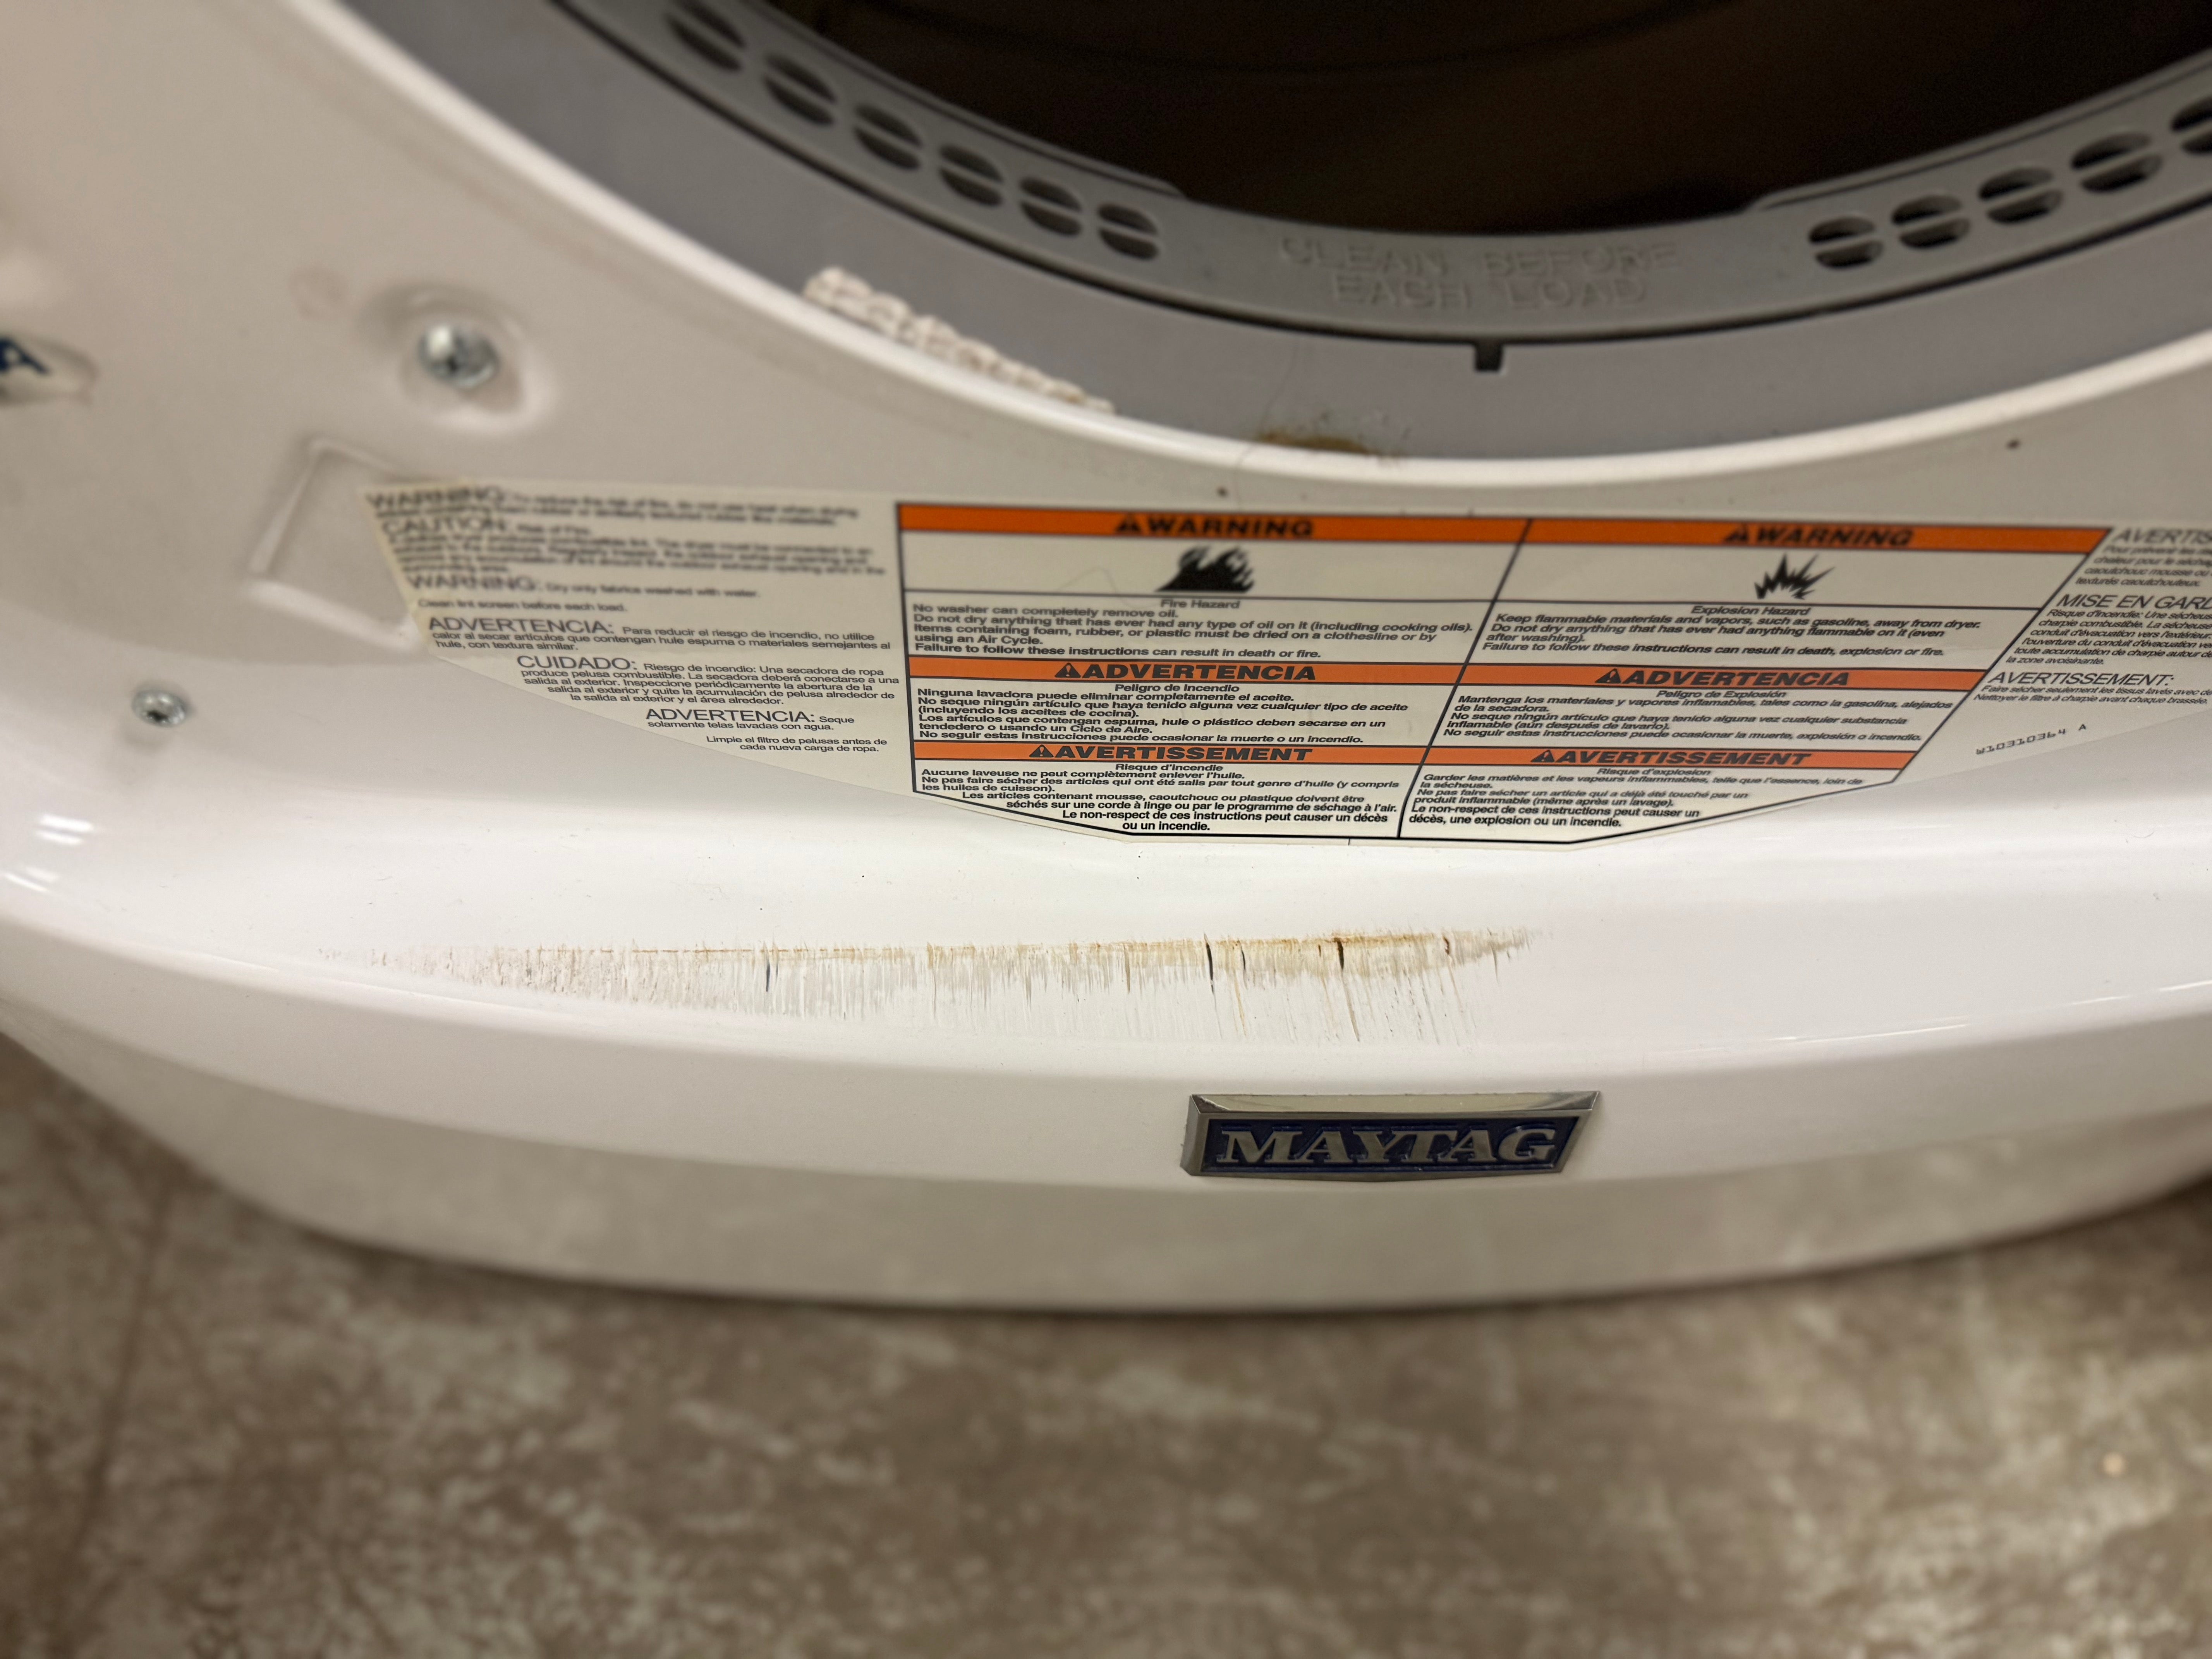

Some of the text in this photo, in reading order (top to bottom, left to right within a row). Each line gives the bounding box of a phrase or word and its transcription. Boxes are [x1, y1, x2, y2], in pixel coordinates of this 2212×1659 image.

[1279, 237, 1676, 276] CLEAN BEFORE
[1332, 274, 1647, 308] EACH LOAD
[1149, 518, 1314, 536] WARNING
[1758, 528, 1913, 546] WARNING
[1160, 600, 1240, 609] Fire Hazard
[2056, 594, 2118, 607] MISE
[2116, 595, 2154, 608] EN
[1691, 606, 1811, 616] Explosion Hazard
[429, 617, 615, 634] ADVERTENCIA:
[622, 627, 651, 635] Para
[654, 627, 694, 636] reducir
[712, 629, 748, 639] riesgo
[751, 630, 766, 638] de
[769, 630, 820, 640] incendio,
[842, 632, 874, 641] utilice
[915, 643, 962, 653] Failure
[965, 644, 979, 653] to
[982, 644, 1024, 654] follow
[1027, 645, 1065, 654] these
[1069, 646, 1149, 656] instructions
[1181, 647, 1219, 656] result
[1222, 648, 1234, 657] in
[1238, 648, 1275, 657] death
[1297, 649, 1321, 658] fire.
[1482, 642, 1528, 651] Failure
[1549, 643, 1590, 652] follow
[1592, 644, 1629, 652] these
[1632, 645, 1712, 653] instructions
[1741, 646, 1780, 654] result
[1797, 647, 1835, 655] death,
[1839, 647, 1902, 656] explosion
[517, 655, 637, 670] CUIDADO:
[644, 663, 684, 673] Riesgo
[687, 664, 702, 672] de
[705, 665, 756, 673] incendio:
[759, 666, 783, 674] Una
[787, 666, 838, 675] secadora
[859, 670, 884, 678] ropa
[1082, 664, 1316, 680] ADVERTENCIA
[1622, 670, 1849, 685] ADVERTENCIA
[1988, 672, 2174, 686] AVERTISSEMENT:
[1115, 684, 1161, 693] Peligro
[1656, 691, 1702, 699] Peligro
[1723, 691, 1786, 699] Explosión
[646, 708, 815, 722] ADVERTENCIA:
[919, 722, 984, 731] tendedero
[999, 723, 1046, 732] usando
[1070, 724, 1102, 733] Ciclo
[1105, 725, 1121, 733] de
[1123, 725, 1152, 733] Aire.
[706, 736, 742, 744] Limpie
[799, 737, 839, 746] pelusas
[1051, 746, 1312, 761] AVERTISSEMENT
[1556, 751, 1812, 765] AVERTISSEMENT
[1115, 764, 1158, 772] Risque
[1597, 768, 1711, 777] Risque d'explosion
[1098, 801, 1131, 809] corde
[1144, 801, 1171, 811] linge
[1227, 804, 1293, 812] programme
[1314, 803, 1361, 813] séchage
[1411, 804, 1426, 812] Le
[1429, 804, 1498, 815] non-respect
[1501, 805, 1515, 814] de
[1542, 806, 1611, 816] instructions
[1614, 808, 1640, 817] peut
[1062, 810, 1077, 819] Le
[1080, 810, 1149, 821] non-respect
[1152, 811, 1167, 819] de
[1194, 811, 1261, 820] instructions
[1265, 812, 1291, 822] peut
[1353, 813, 1388, 821] décès
[1409, 814, 1446, 825] décès,
[1474, 815, 1530, 827] explosion
[1570, 817, 1621, 826] incendie.
[1159, 822, 1209, 831] incendie.
[1216, 1127, 1555, 1163] MAYTAG
